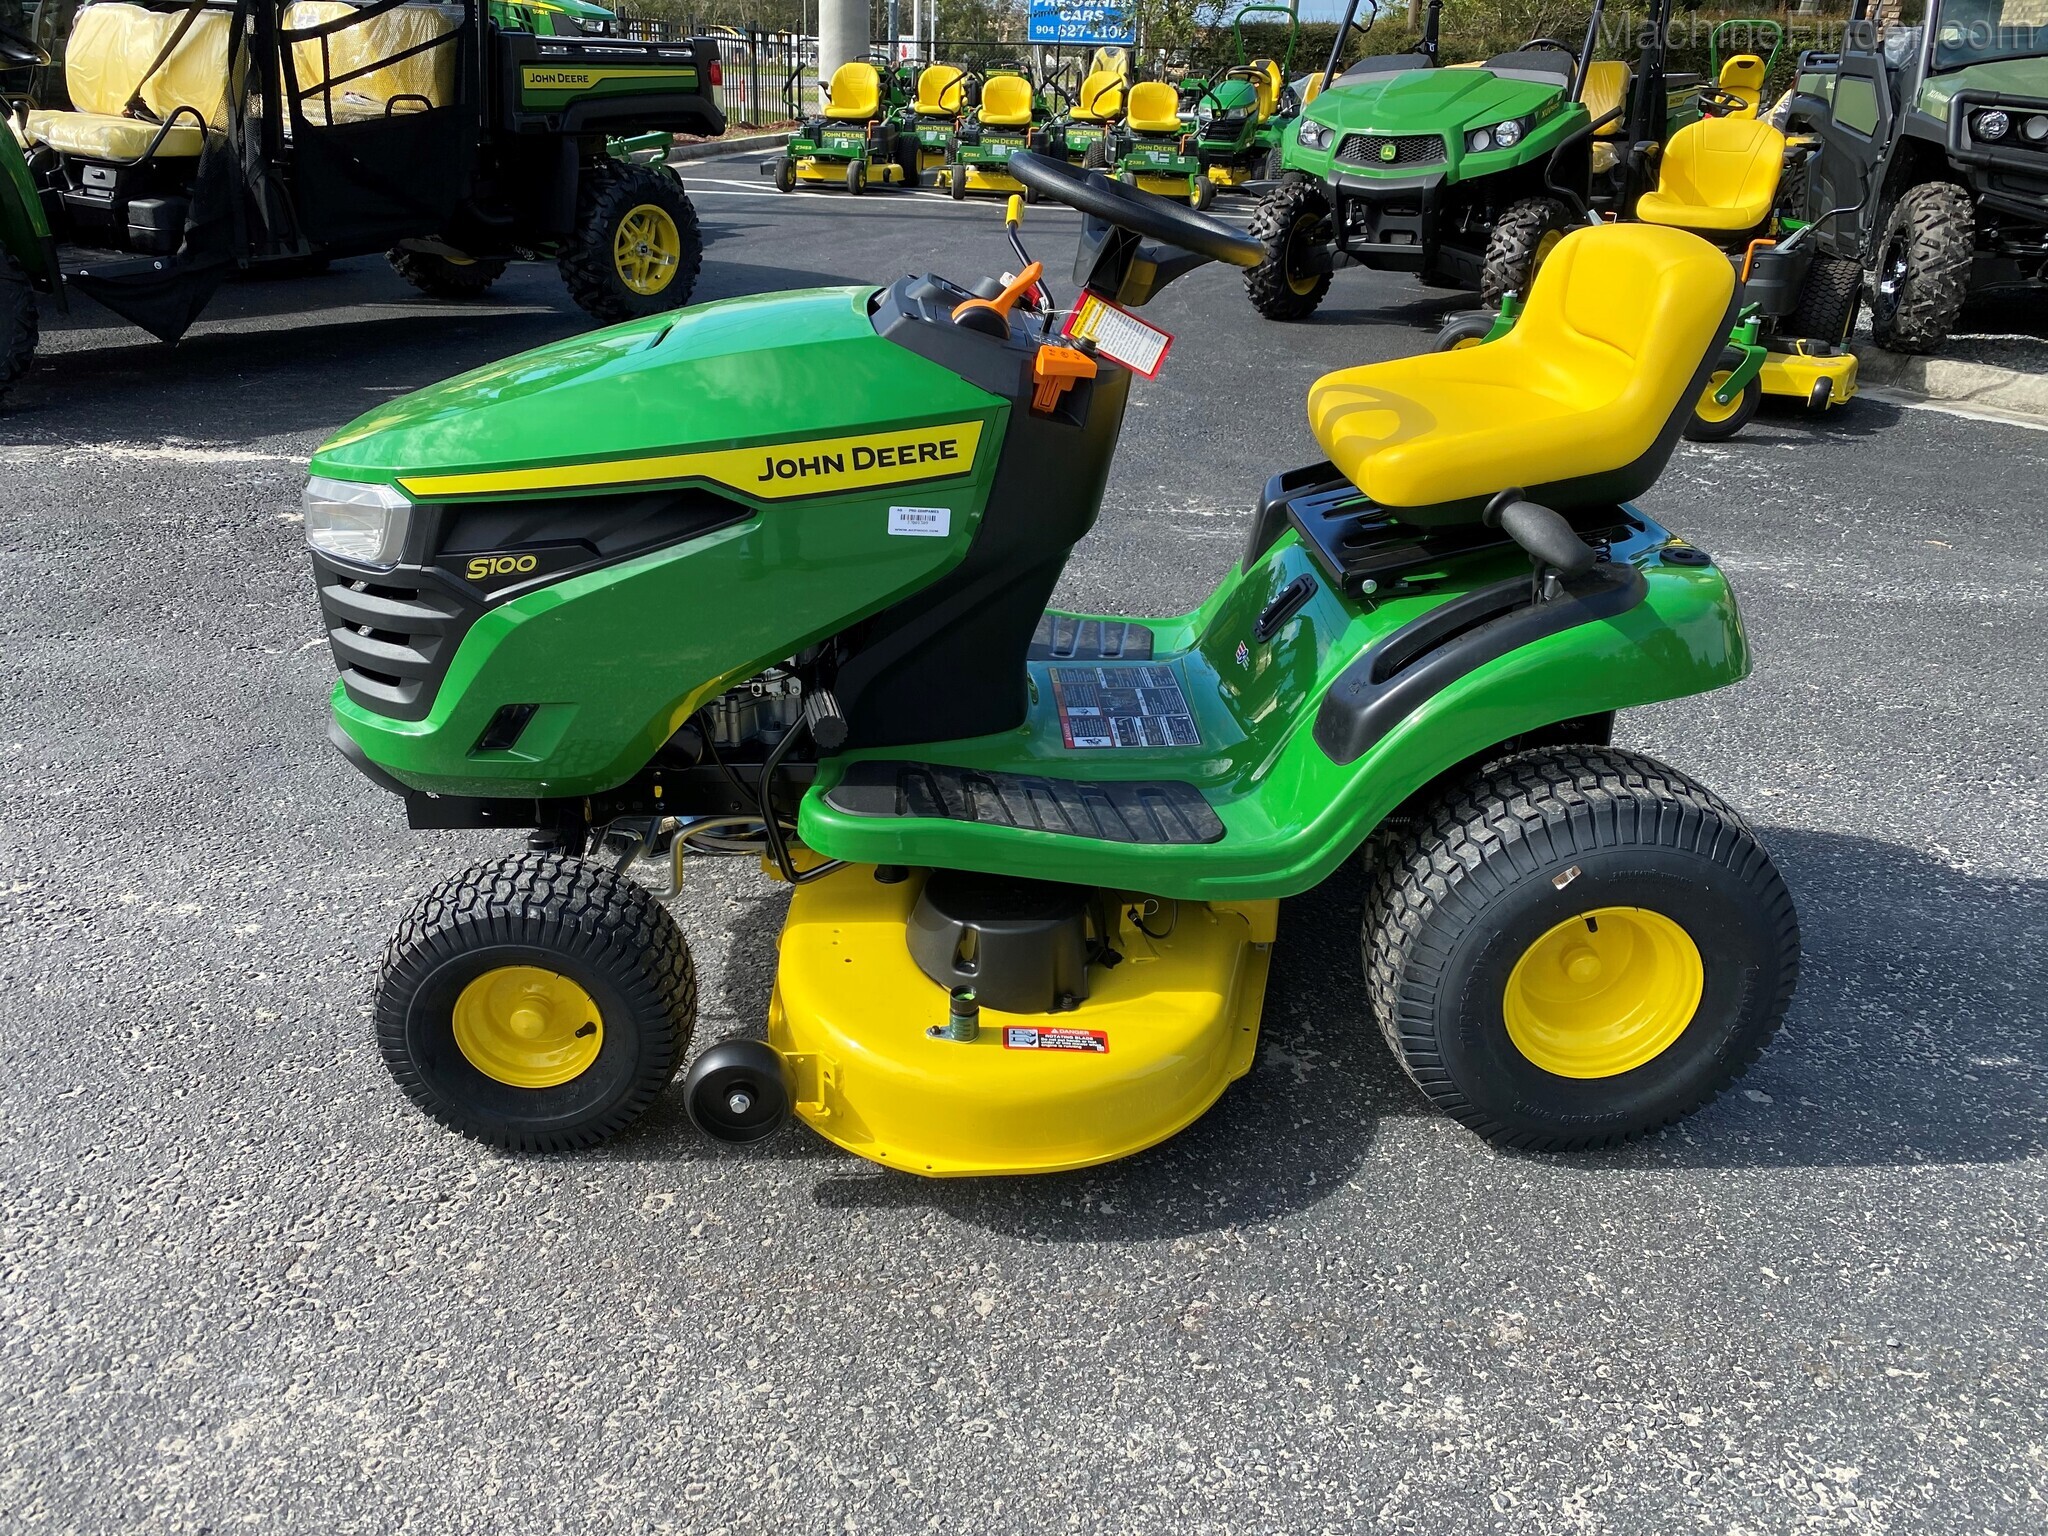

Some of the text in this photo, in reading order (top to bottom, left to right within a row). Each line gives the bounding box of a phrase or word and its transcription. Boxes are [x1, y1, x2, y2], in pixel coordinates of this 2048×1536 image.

[1060, 10, 1104, 22] CARS
[1036, 25, 1055, 34] 904
[530, 73, 590, 83] JOHN DEERE
[823, 131, 841, 139] JOHN
[1001, 138, 1024, 146] DEERE
[1134, 143, 1153, 151] JOHN
[758, 439, 959, 482] JOHN DEERE
[467, 555, 537, 579] S100
